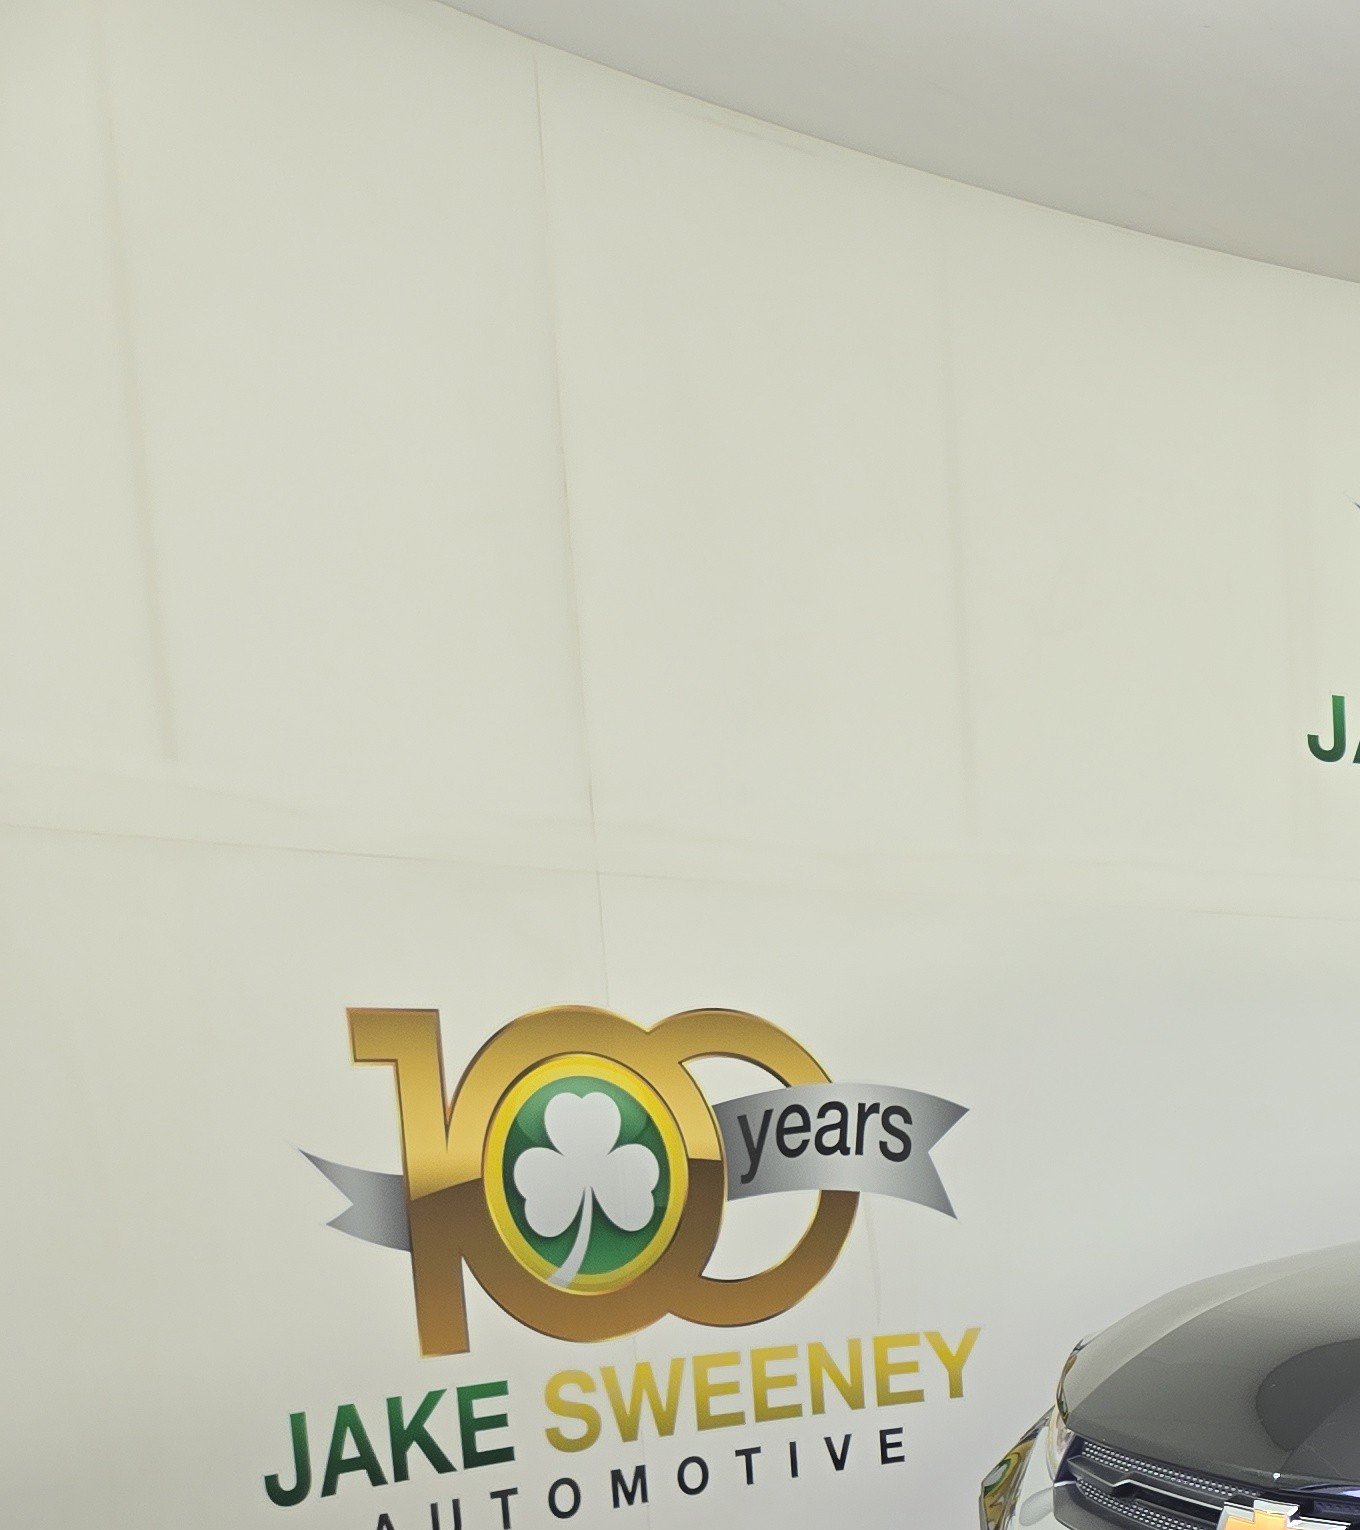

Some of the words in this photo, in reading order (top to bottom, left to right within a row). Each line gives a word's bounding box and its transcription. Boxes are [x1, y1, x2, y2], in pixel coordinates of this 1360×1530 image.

[737, 1096, 914, 1185] years
[263, 1380, 517, 1508] JAKE
[544, 1327, 982, 1453] SWEENEY
